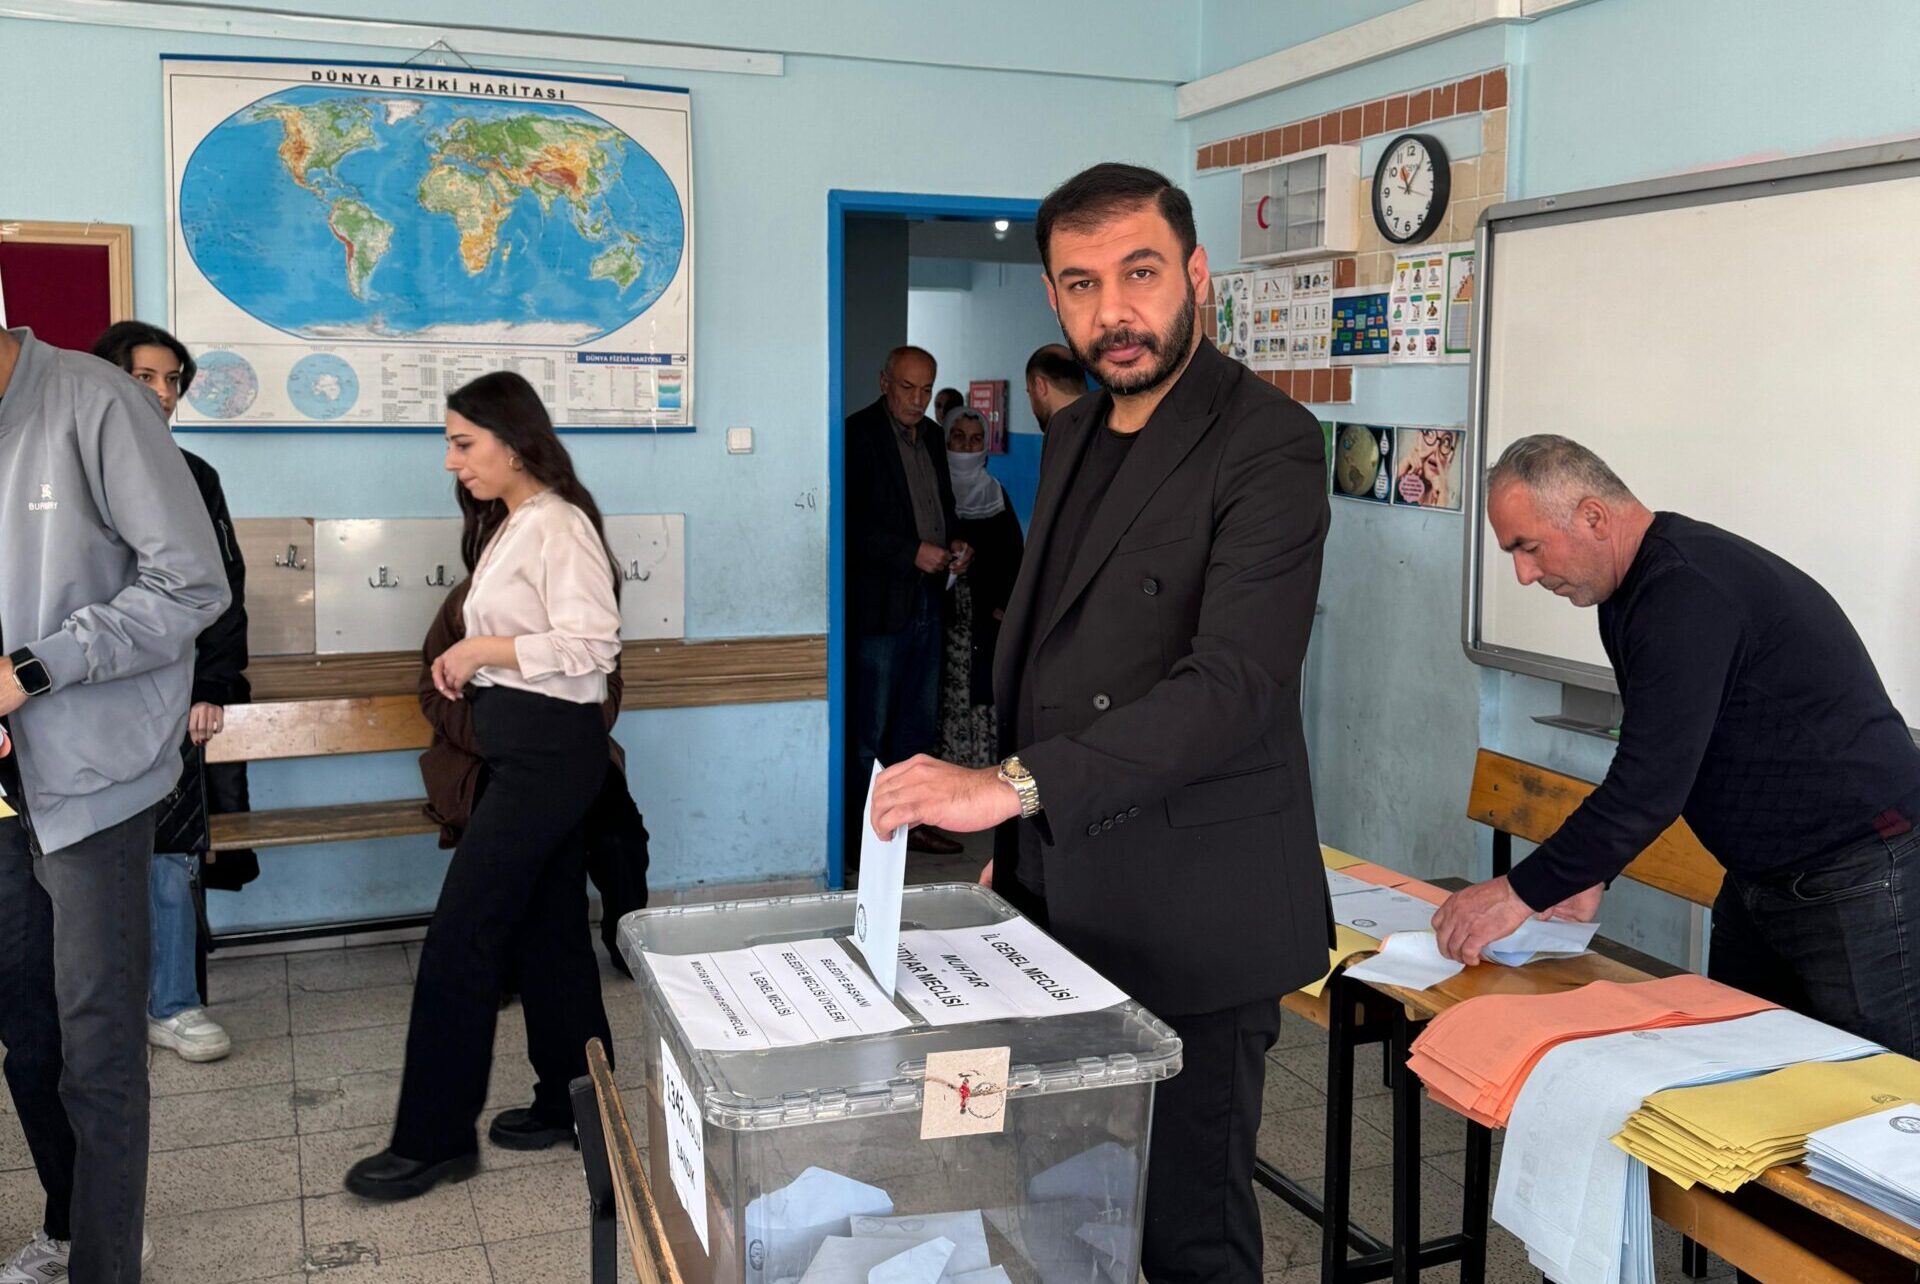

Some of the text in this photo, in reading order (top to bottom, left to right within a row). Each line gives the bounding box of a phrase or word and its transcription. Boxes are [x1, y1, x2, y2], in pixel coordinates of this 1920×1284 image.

[311, 70, 564, 99] DÜNYA FİZİKİ HARİTASI
[1397, 151, 1402, 164] 11
[1407, 145, 1416, 156] 12
[1389, 167, 1398, 178] 10
[1384, 187, 1391, 198] 9
[1386, 205, 1393, 216] 8
[1393, 217, 1400, 228] 7
[1404, 220, 1411, 231] 6
[1417, 214, 1423, 226] 5
[781, 952, 809, 976] BELEDİYE
[820, 958, 851, 982] BELEDİYE
[940, 954, 989, 988] MUHTAR
[980, 932, 1079, 1001] İL GENEL MECLİSİ
[754, 976, 774, 994] GENEL
[915, 973, 969, 1007] MECLİSİ
[666, 1073, 685, 1126] 1342
